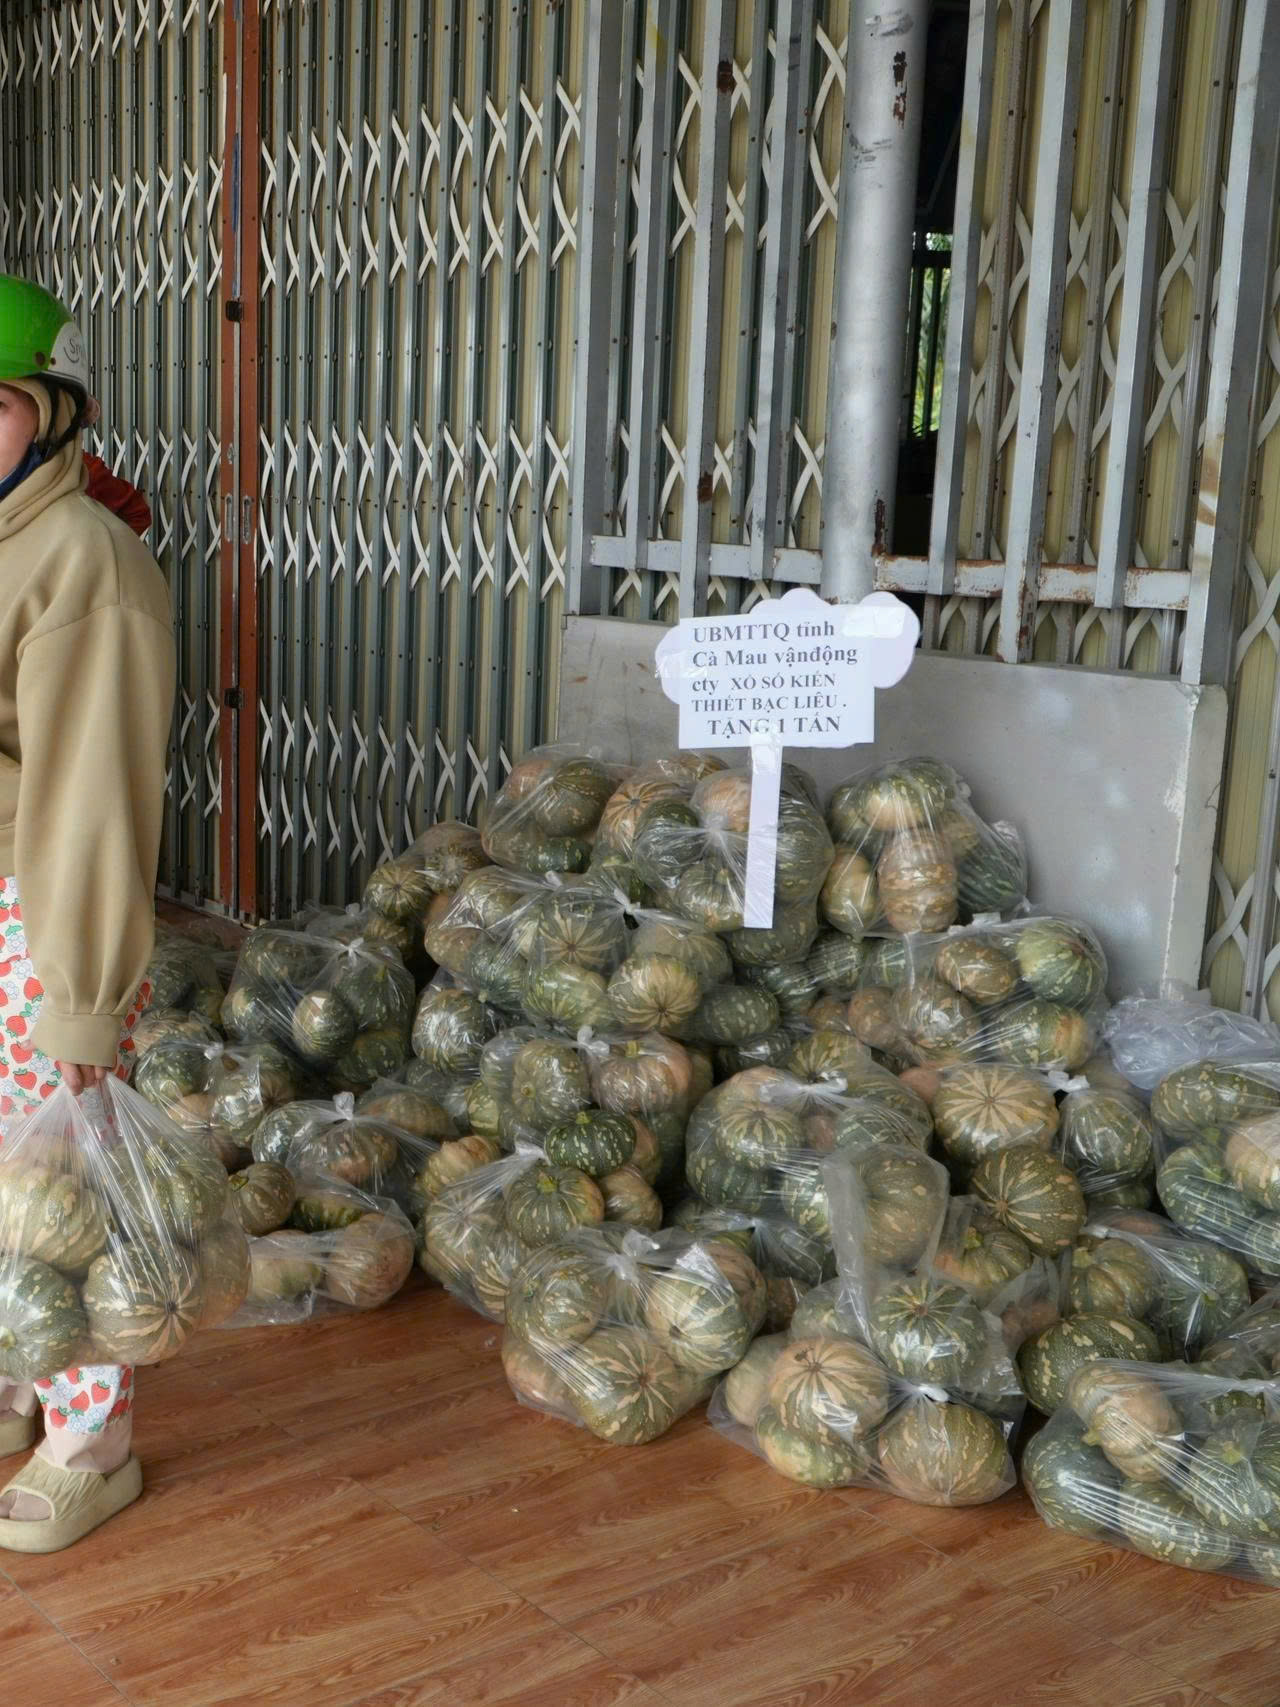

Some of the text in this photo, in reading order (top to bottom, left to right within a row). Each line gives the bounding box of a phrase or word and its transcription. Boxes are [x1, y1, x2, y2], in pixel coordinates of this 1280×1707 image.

[693, 622, 790, 643] UBMTTQ
[692, 650, 718, 668] Cà
[724, 649, 768, 666] Mau
[692, 678, 720, 696] cty
[751, 696, 789, 714] BẠC
[778, 718, 785, 734] 1
